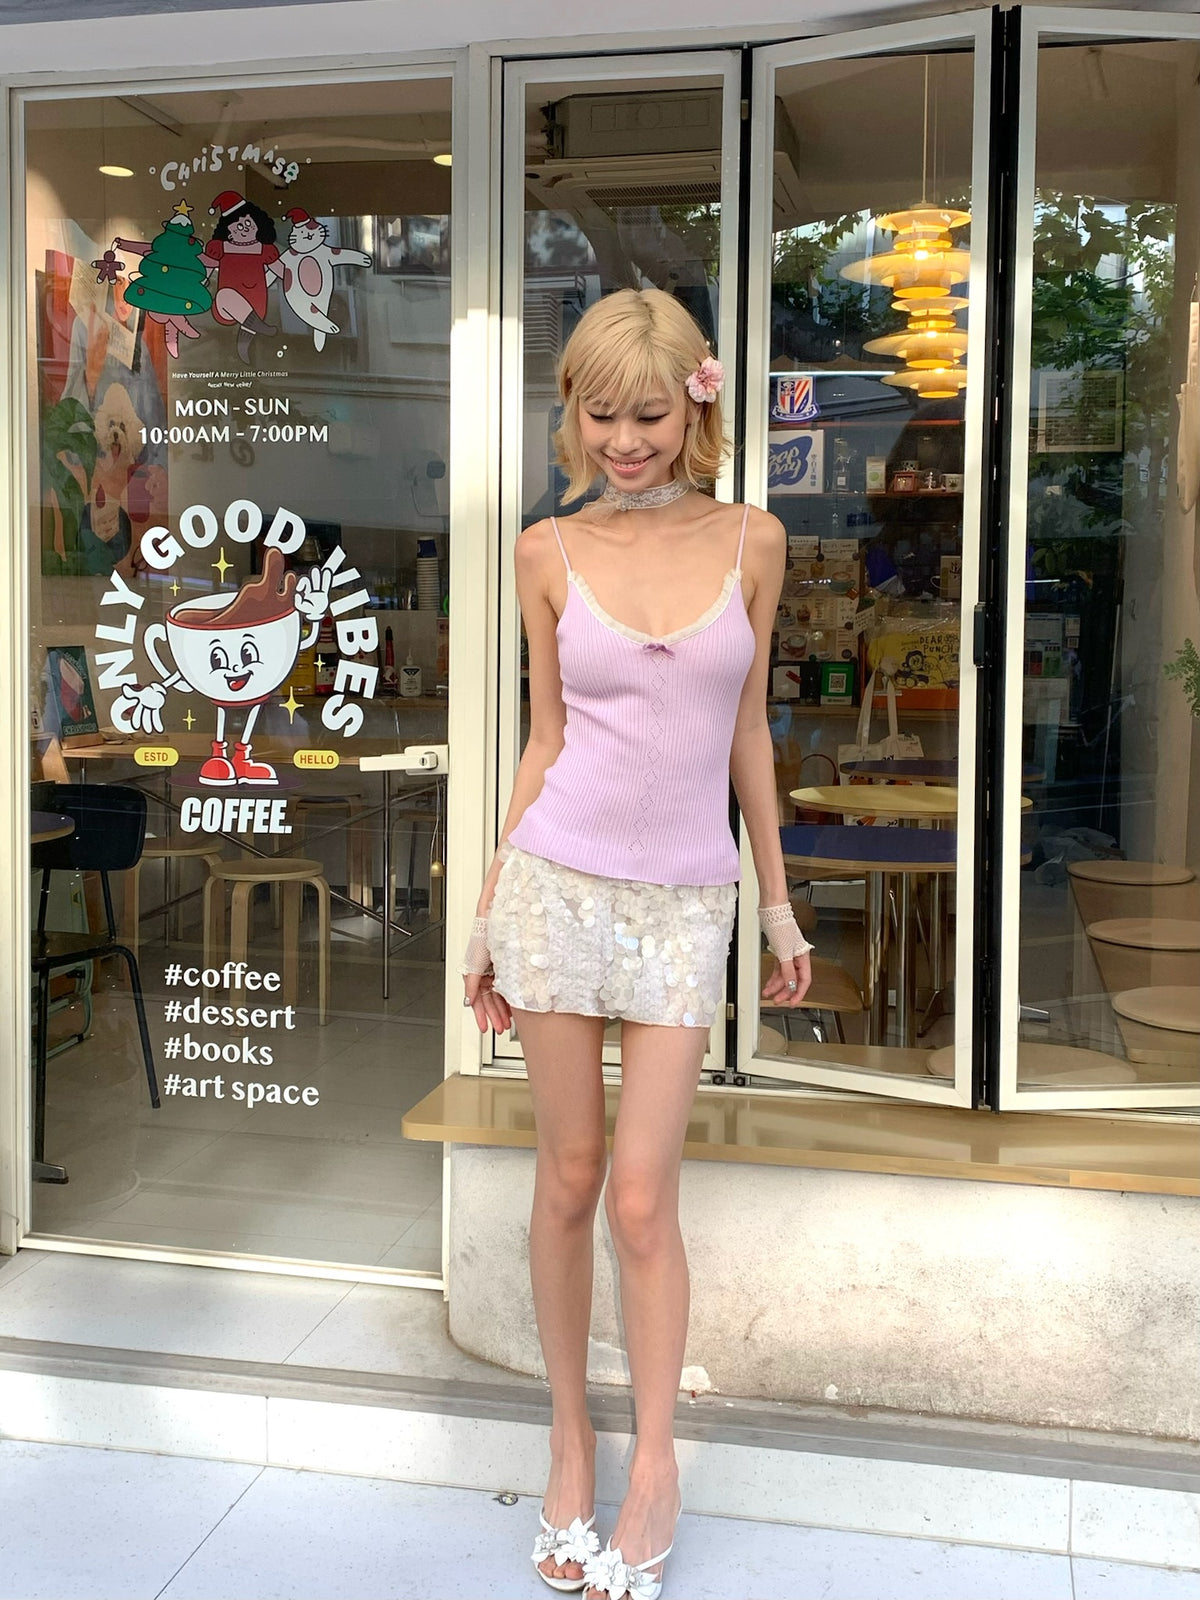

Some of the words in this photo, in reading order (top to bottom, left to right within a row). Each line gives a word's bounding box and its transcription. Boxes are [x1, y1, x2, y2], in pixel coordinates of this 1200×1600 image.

[220, 371, 239, 379] Merry
[257, 370, 289, 378] Christmas
[175, 399, 229, 417] MON
[244, 398, 290, 416] SUN
[138, 426, 230, 445] 10:00AM
[250, 425, 328, 443] 7:00PM
[140, 499, 307, 570] GOOD
[320, 545, 379, 738] VIBES
[144, 752, 169, 762] ESTD
[300, 754, 334, 765] HELLO
[179, 797, 293, 834] COFFEE.
[164, 961, 281, 992] #coffee
[164, 996, 296, 1030] #dessert
[164, 1032, 274, 1066] #books
[163, 1073, 225, 1099] #art
[231, 1080, 320, 1109] space
